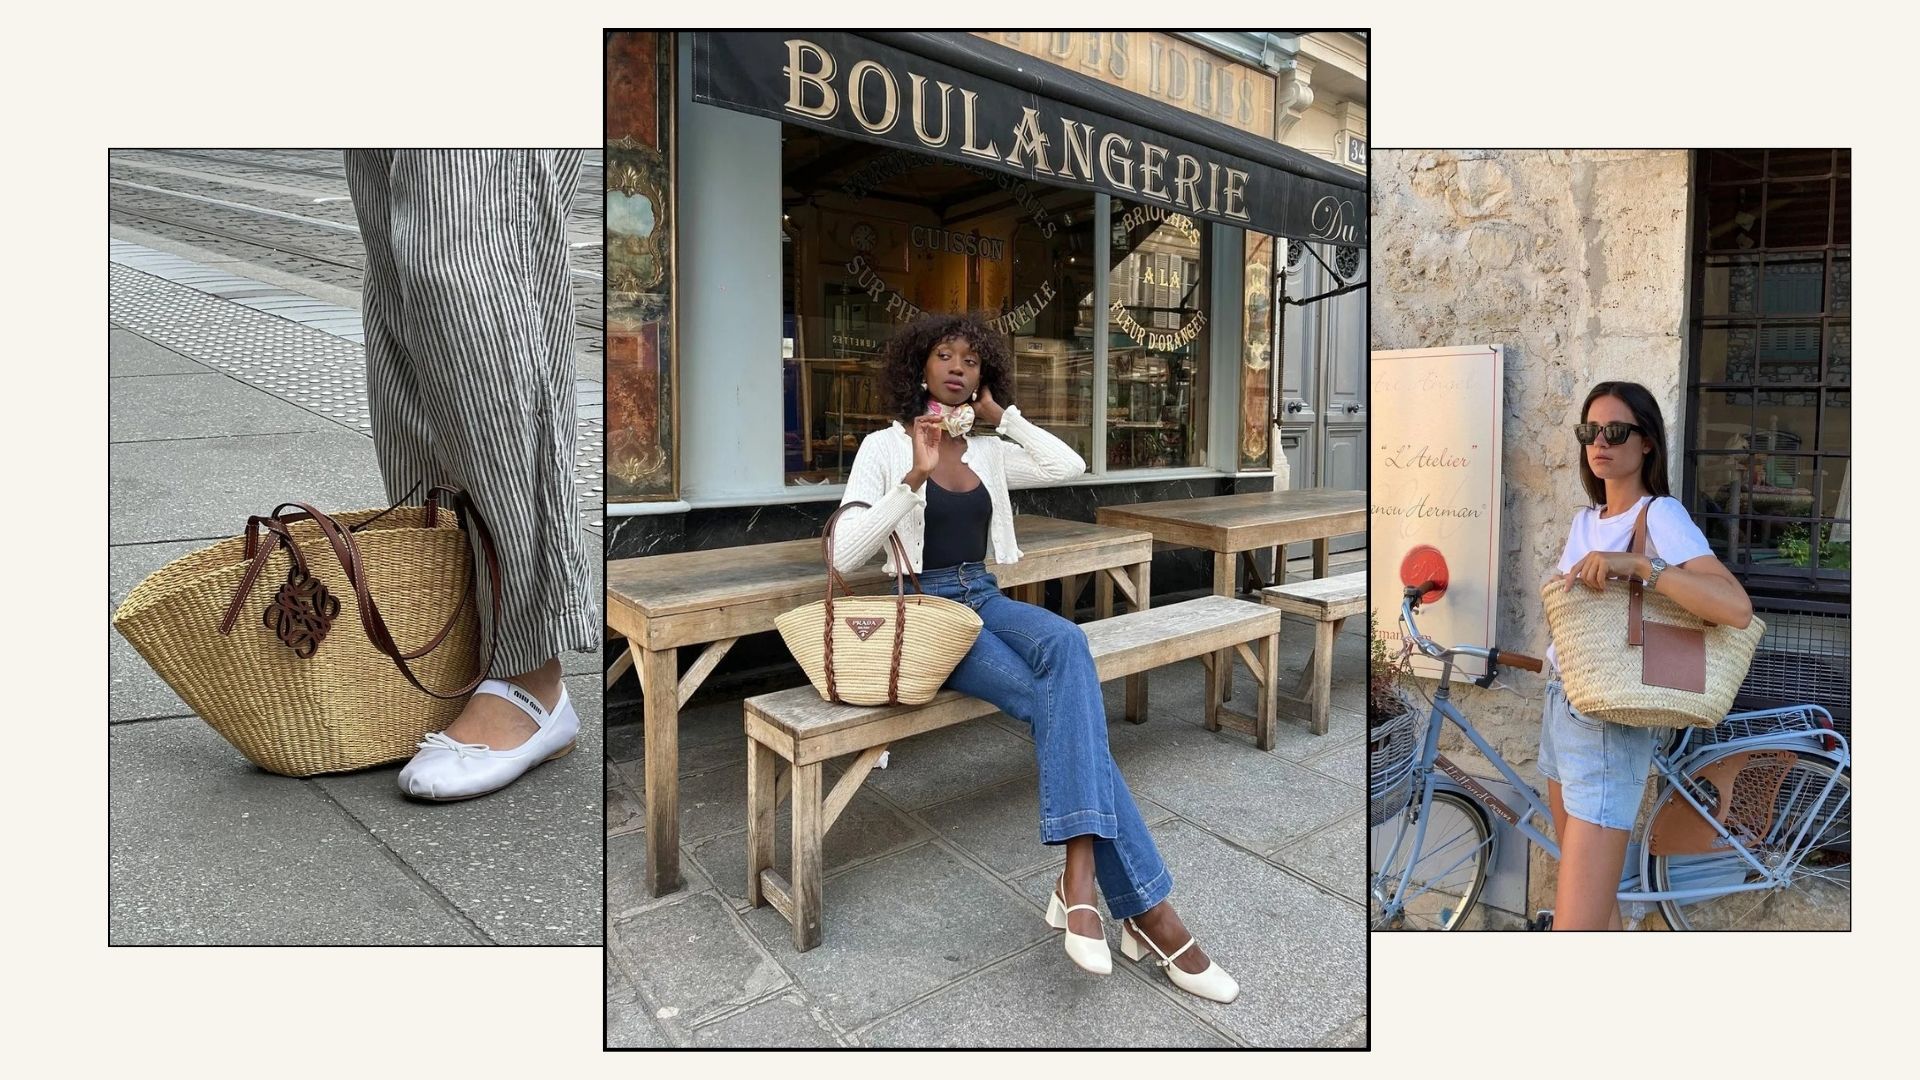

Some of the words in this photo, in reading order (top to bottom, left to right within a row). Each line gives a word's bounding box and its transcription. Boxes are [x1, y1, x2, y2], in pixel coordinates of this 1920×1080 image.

[783, 39, 1251, 221] BOULANGERIE
[1350, 139, 1366, 163] 34
[1122, 204, 1201, 246] BRIOCHES
[1309, 195, 1358, 242] Du
[911, 225, 1004, 261] CUISSON
[846, 255, 885, 302] SUR
[985, 280, 1057, 335] TURELLE
[1160, 268, 1180, 288] LA
[1110, 298, 1146, 346] FLEUR
[1148, 310, 1208, 352] D'ORANGER
